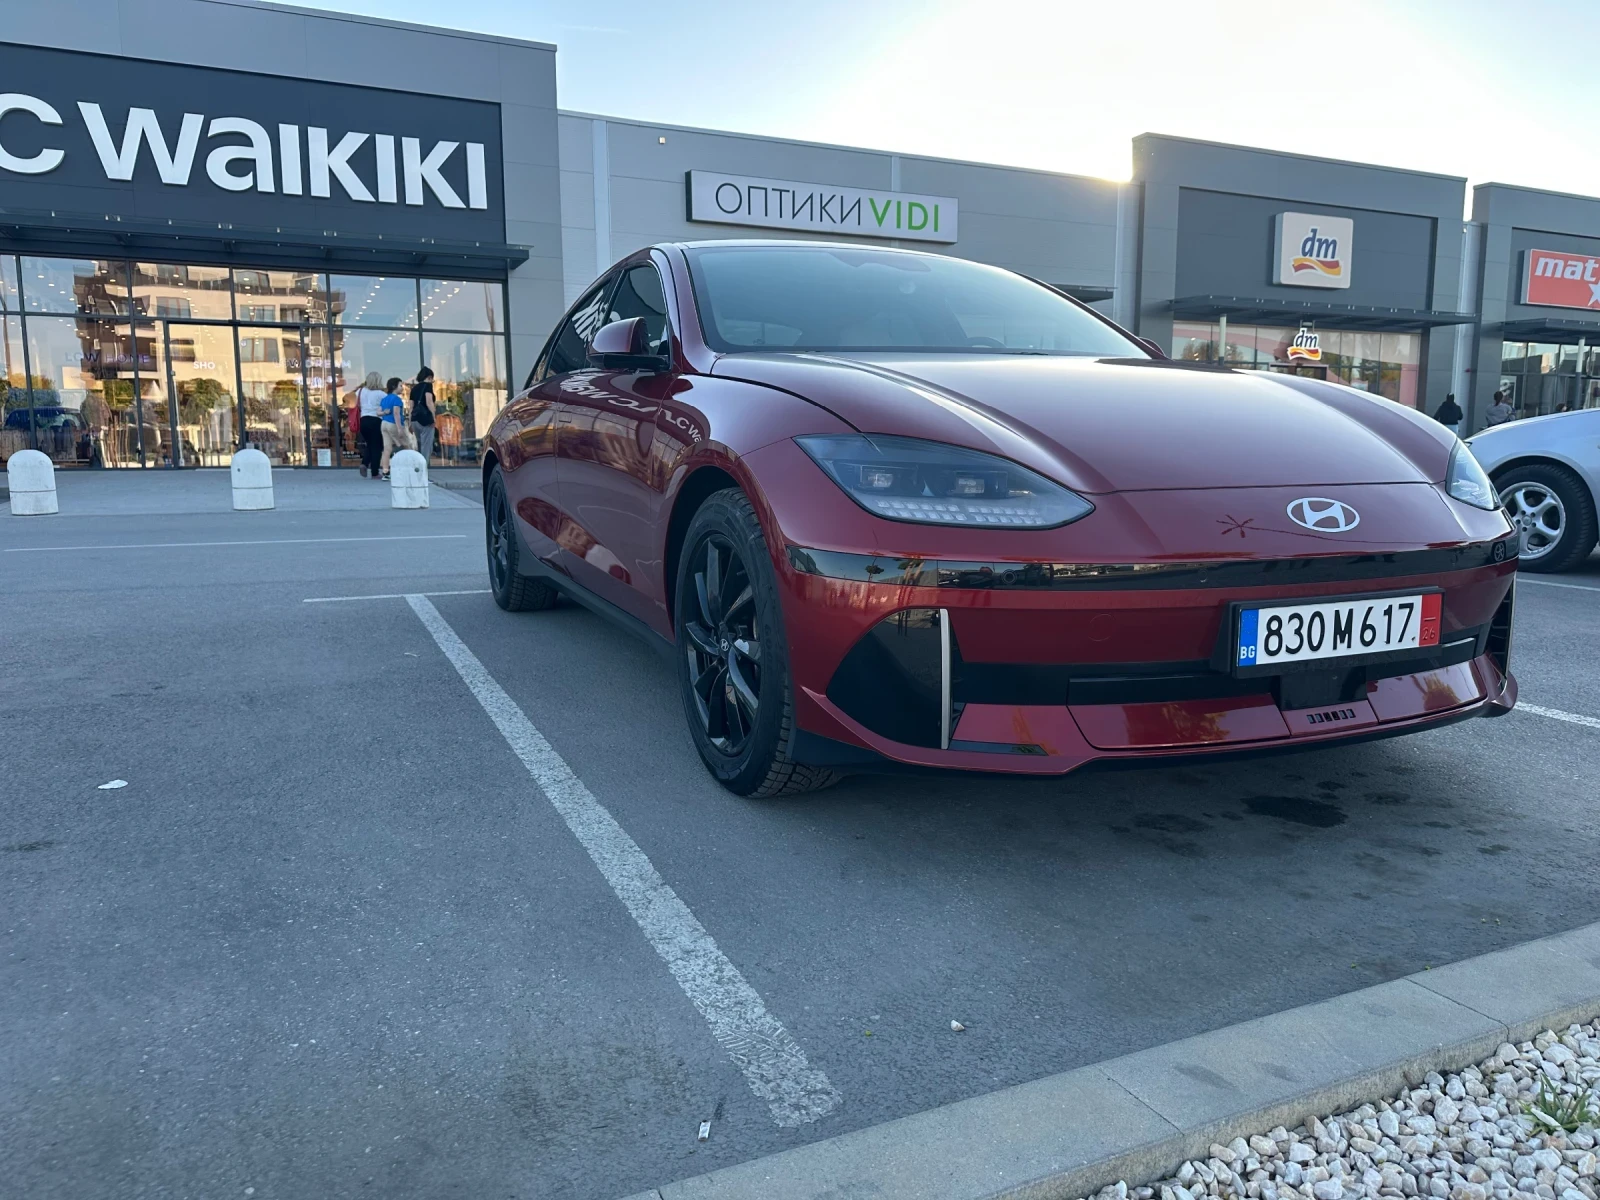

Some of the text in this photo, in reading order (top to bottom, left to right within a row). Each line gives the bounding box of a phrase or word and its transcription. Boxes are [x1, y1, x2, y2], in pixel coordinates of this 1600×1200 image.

[715, 182, 939, 232] ОПТИКИ VIDI
[1301, 228, 1338, 259] dm
[1534, 256, 1599, 282] mat
[1295, 330, 1318, 348] dm
[1240, 645, 1255, 659] BG
